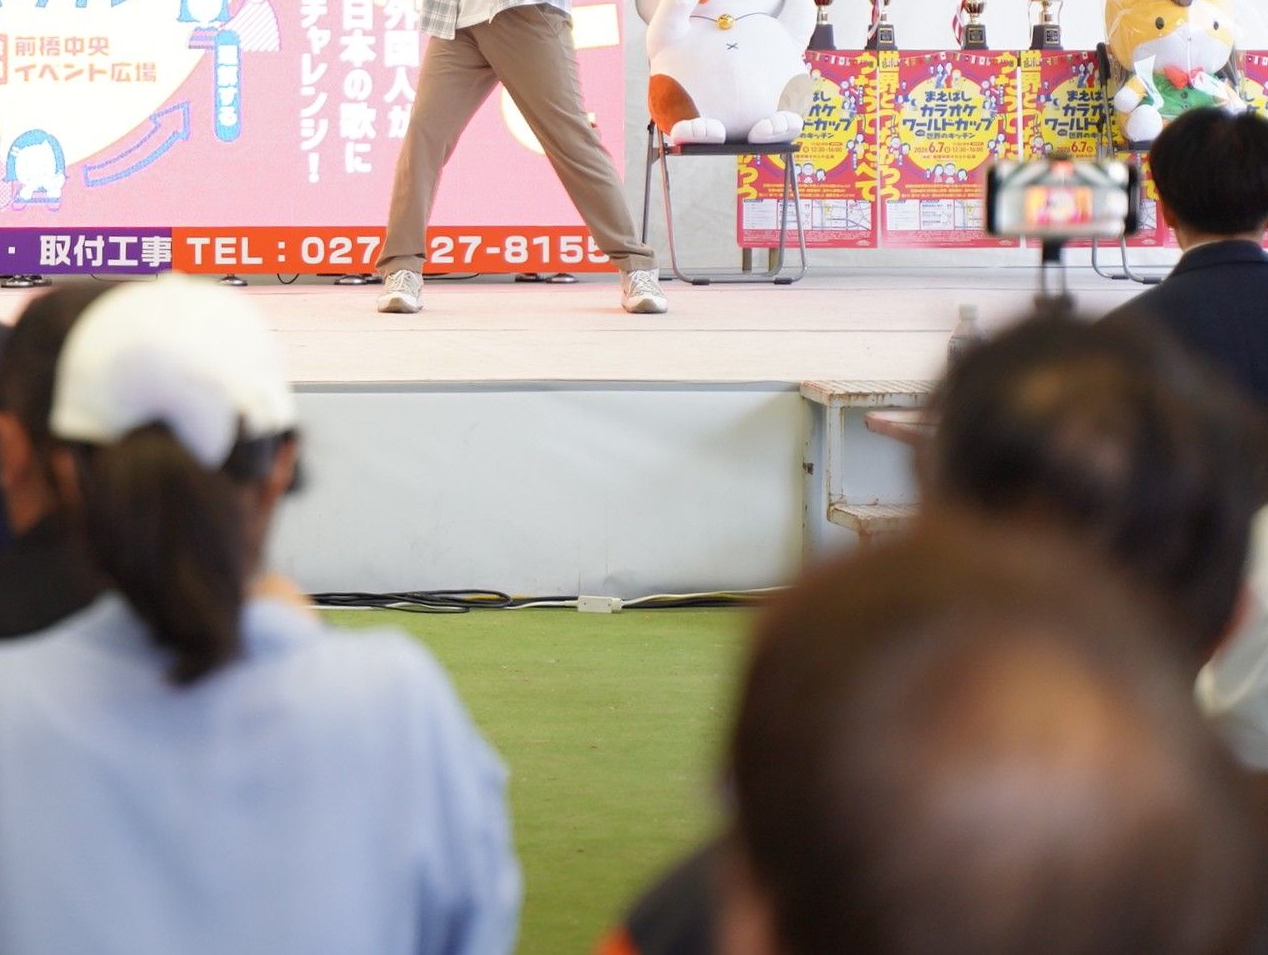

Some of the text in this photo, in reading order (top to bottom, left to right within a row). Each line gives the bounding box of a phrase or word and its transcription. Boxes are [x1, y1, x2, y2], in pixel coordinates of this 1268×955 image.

[14, 35, 110, 57] 前橋中央
[924, 90, 972, 102] まえばし
[920, 104, 977, 117] カラオケ
[902, 117, 995, 131] ワールドカップ
[929, 141, 945, 153] 6.7
[1072, 141, 1087, 153] 6.7
